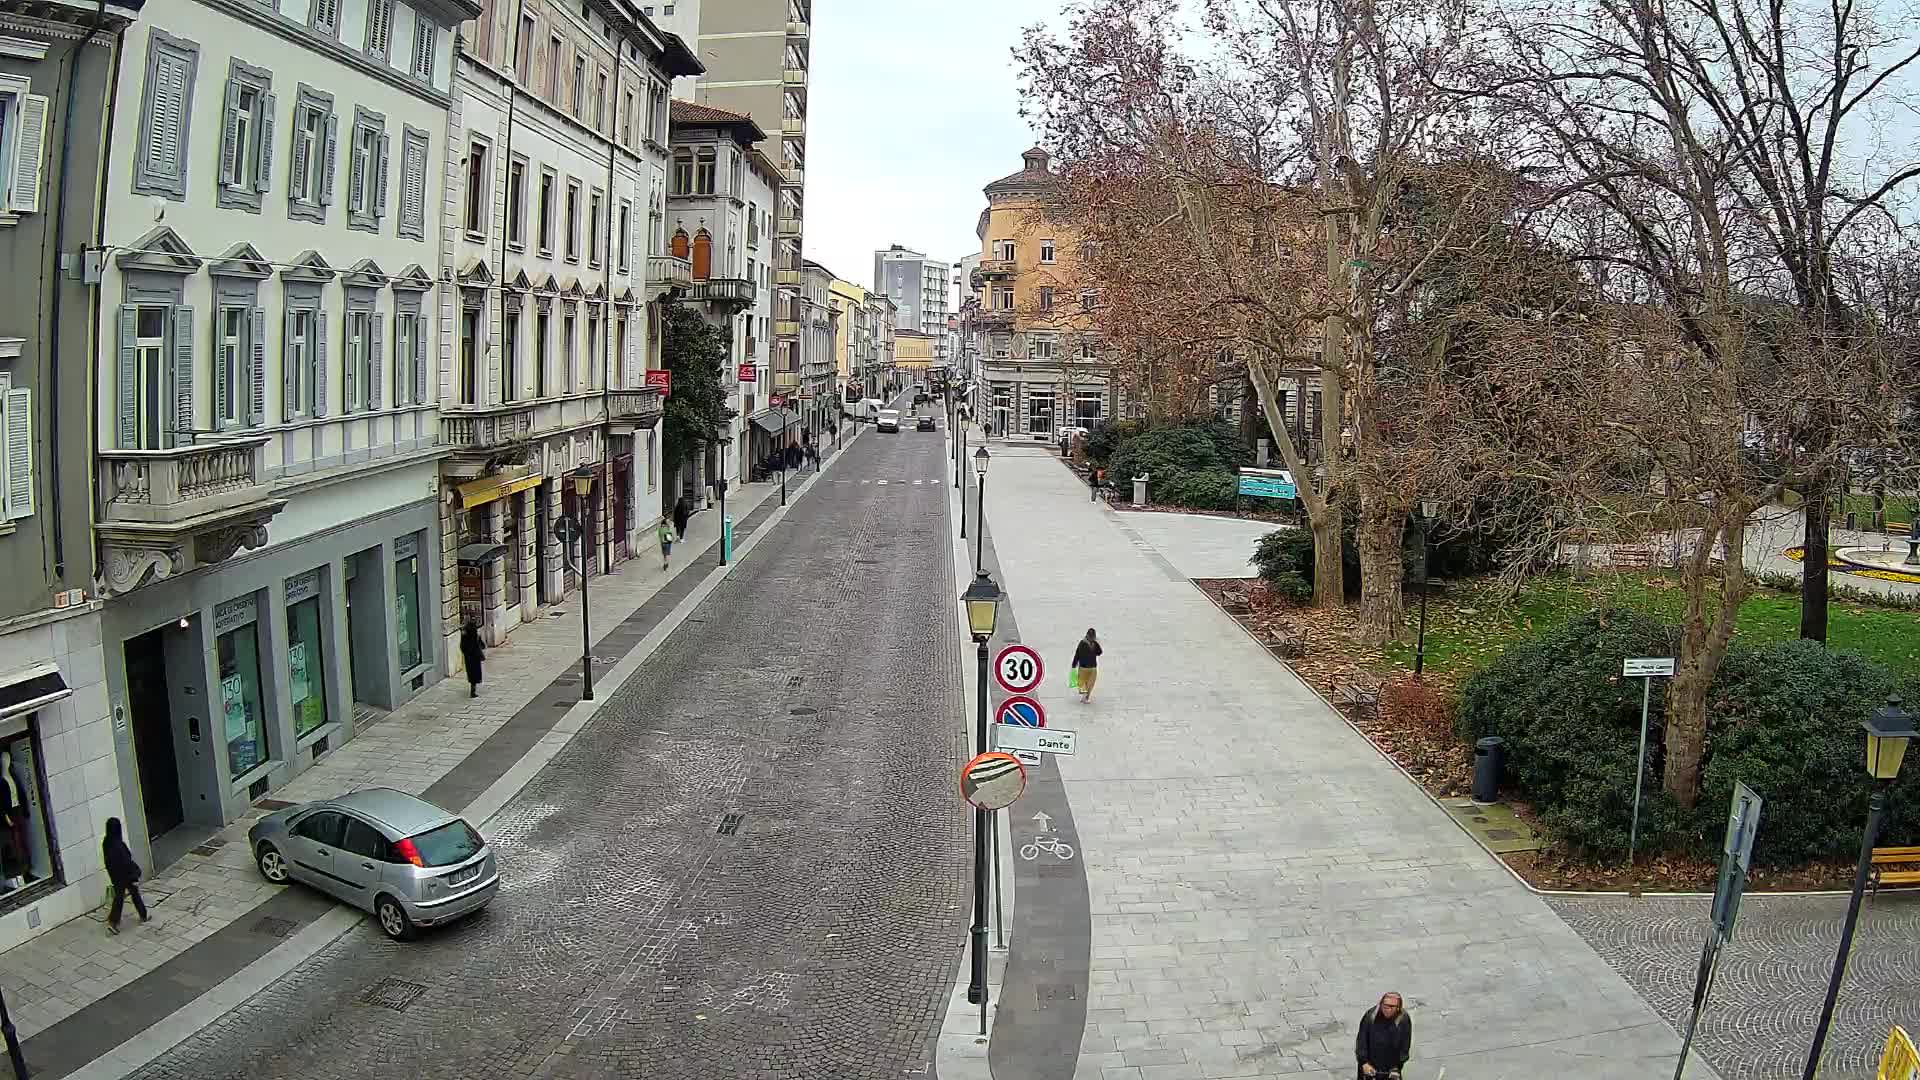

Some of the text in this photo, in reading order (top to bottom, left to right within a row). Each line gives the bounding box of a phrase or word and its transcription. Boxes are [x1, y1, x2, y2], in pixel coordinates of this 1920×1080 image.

[288, 645, 304, 666] 130
[1005, 659, 1033, 680] 30
[223, 677, 241, 701] 130
[1038, 738, 1070, 750] Dante
